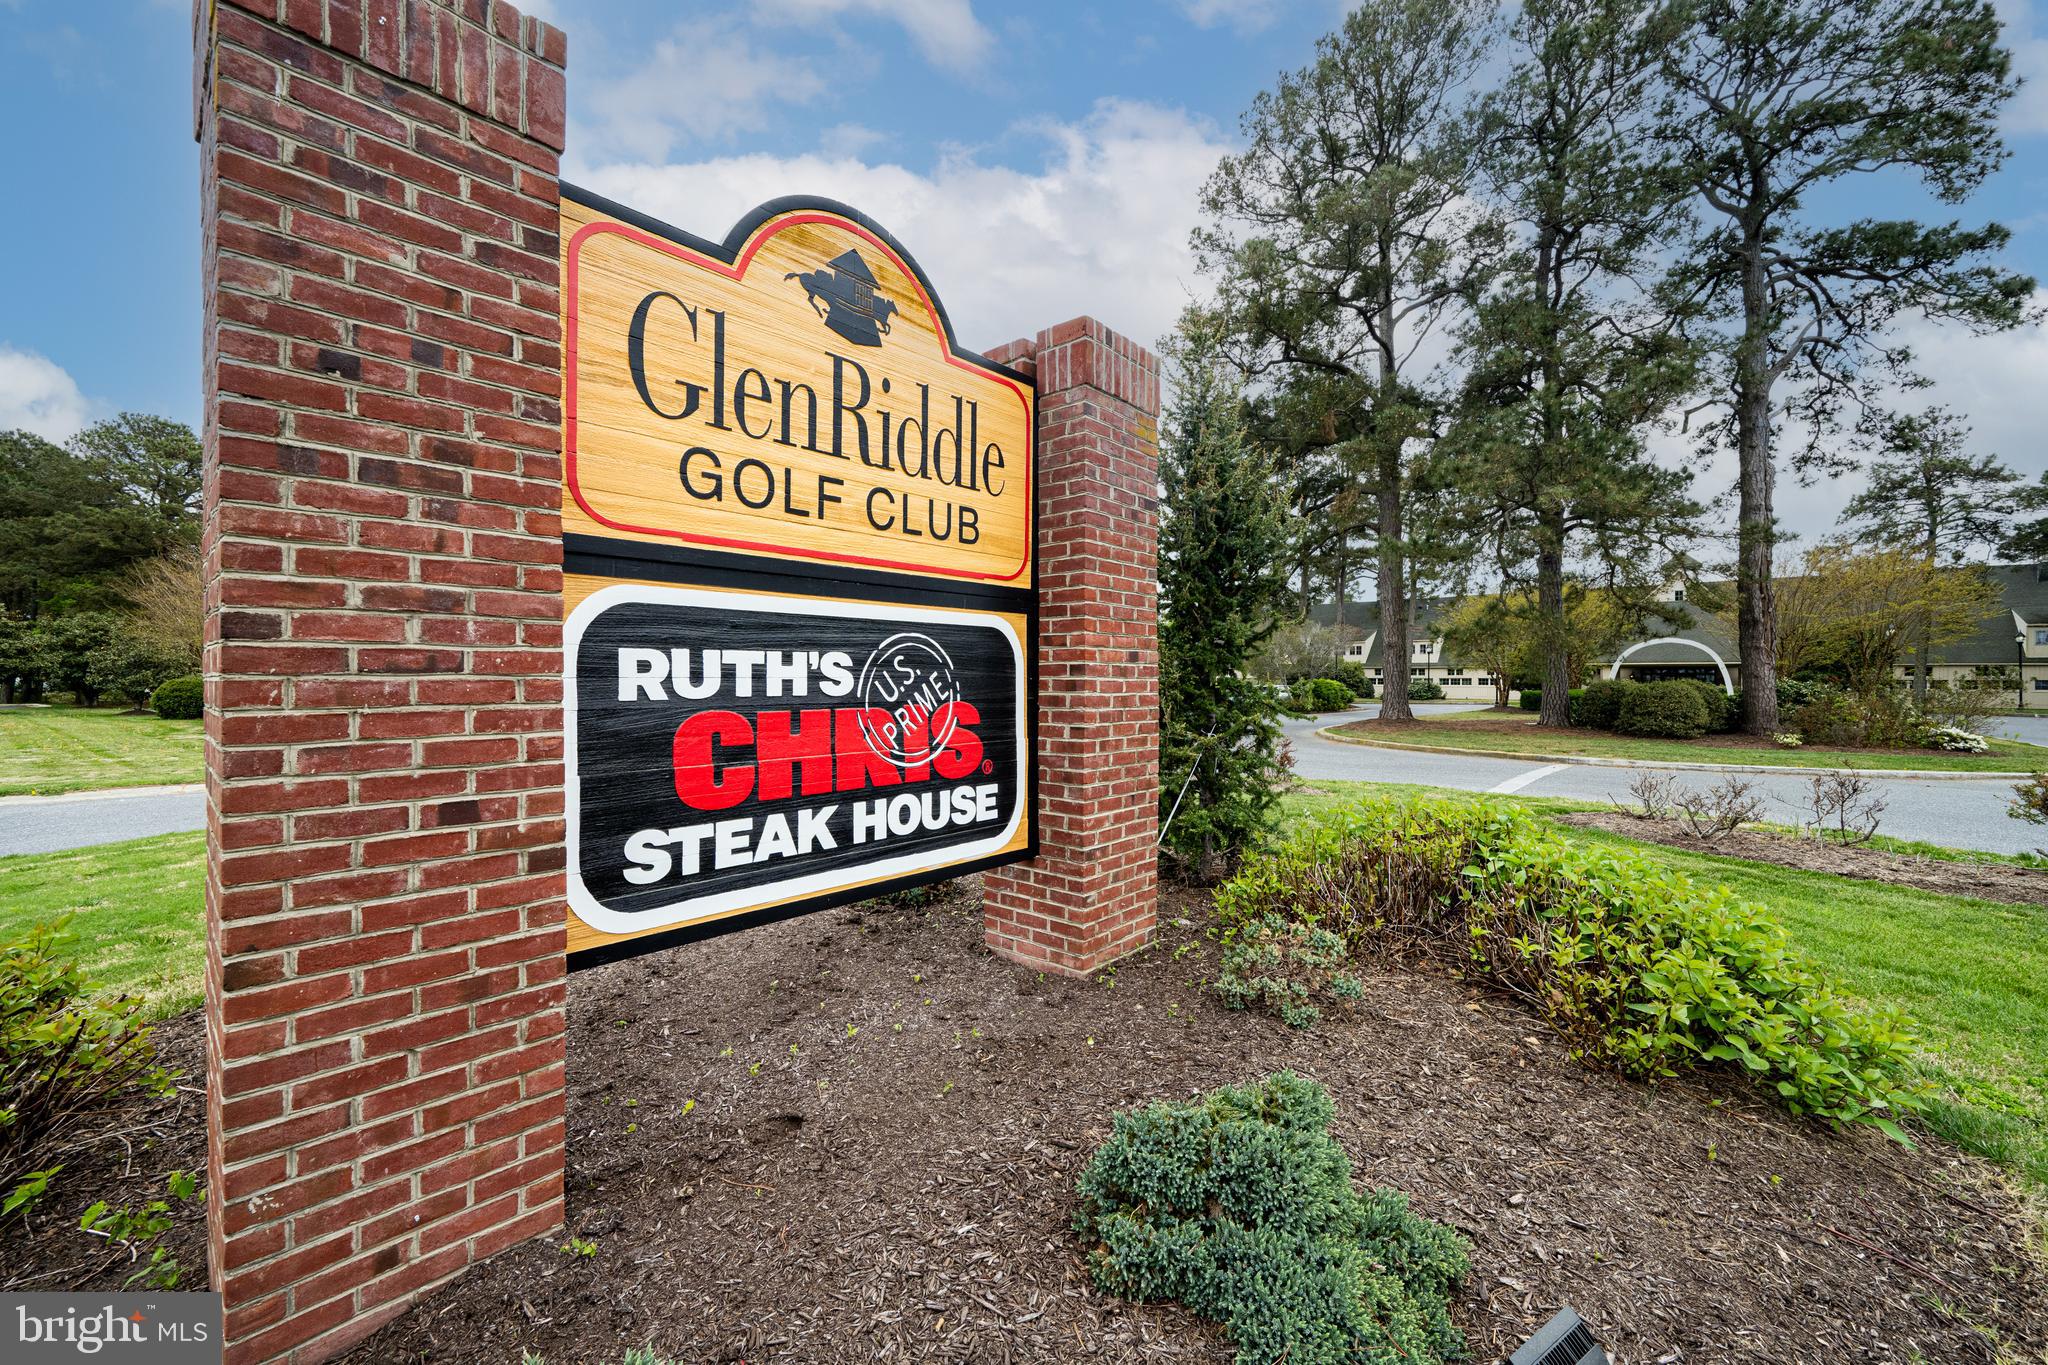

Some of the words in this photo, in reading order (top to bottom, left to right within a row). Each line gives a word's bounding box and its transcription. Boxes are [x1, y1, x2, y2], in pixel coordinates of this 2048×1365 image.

[628, 291, 1005, 496] GlenRiddle
[679, 447, 844, 520] GOLF
[866, 486, 980, 545] CLUB
[618, 647, 854, 701] RUTH'S
[874, 655, 921, 702] U.S.
[882, 671, 949, 750] PRIME
[622, 805, 839, 885] STEAK
[853, 783, 998, 844] HOUSE
